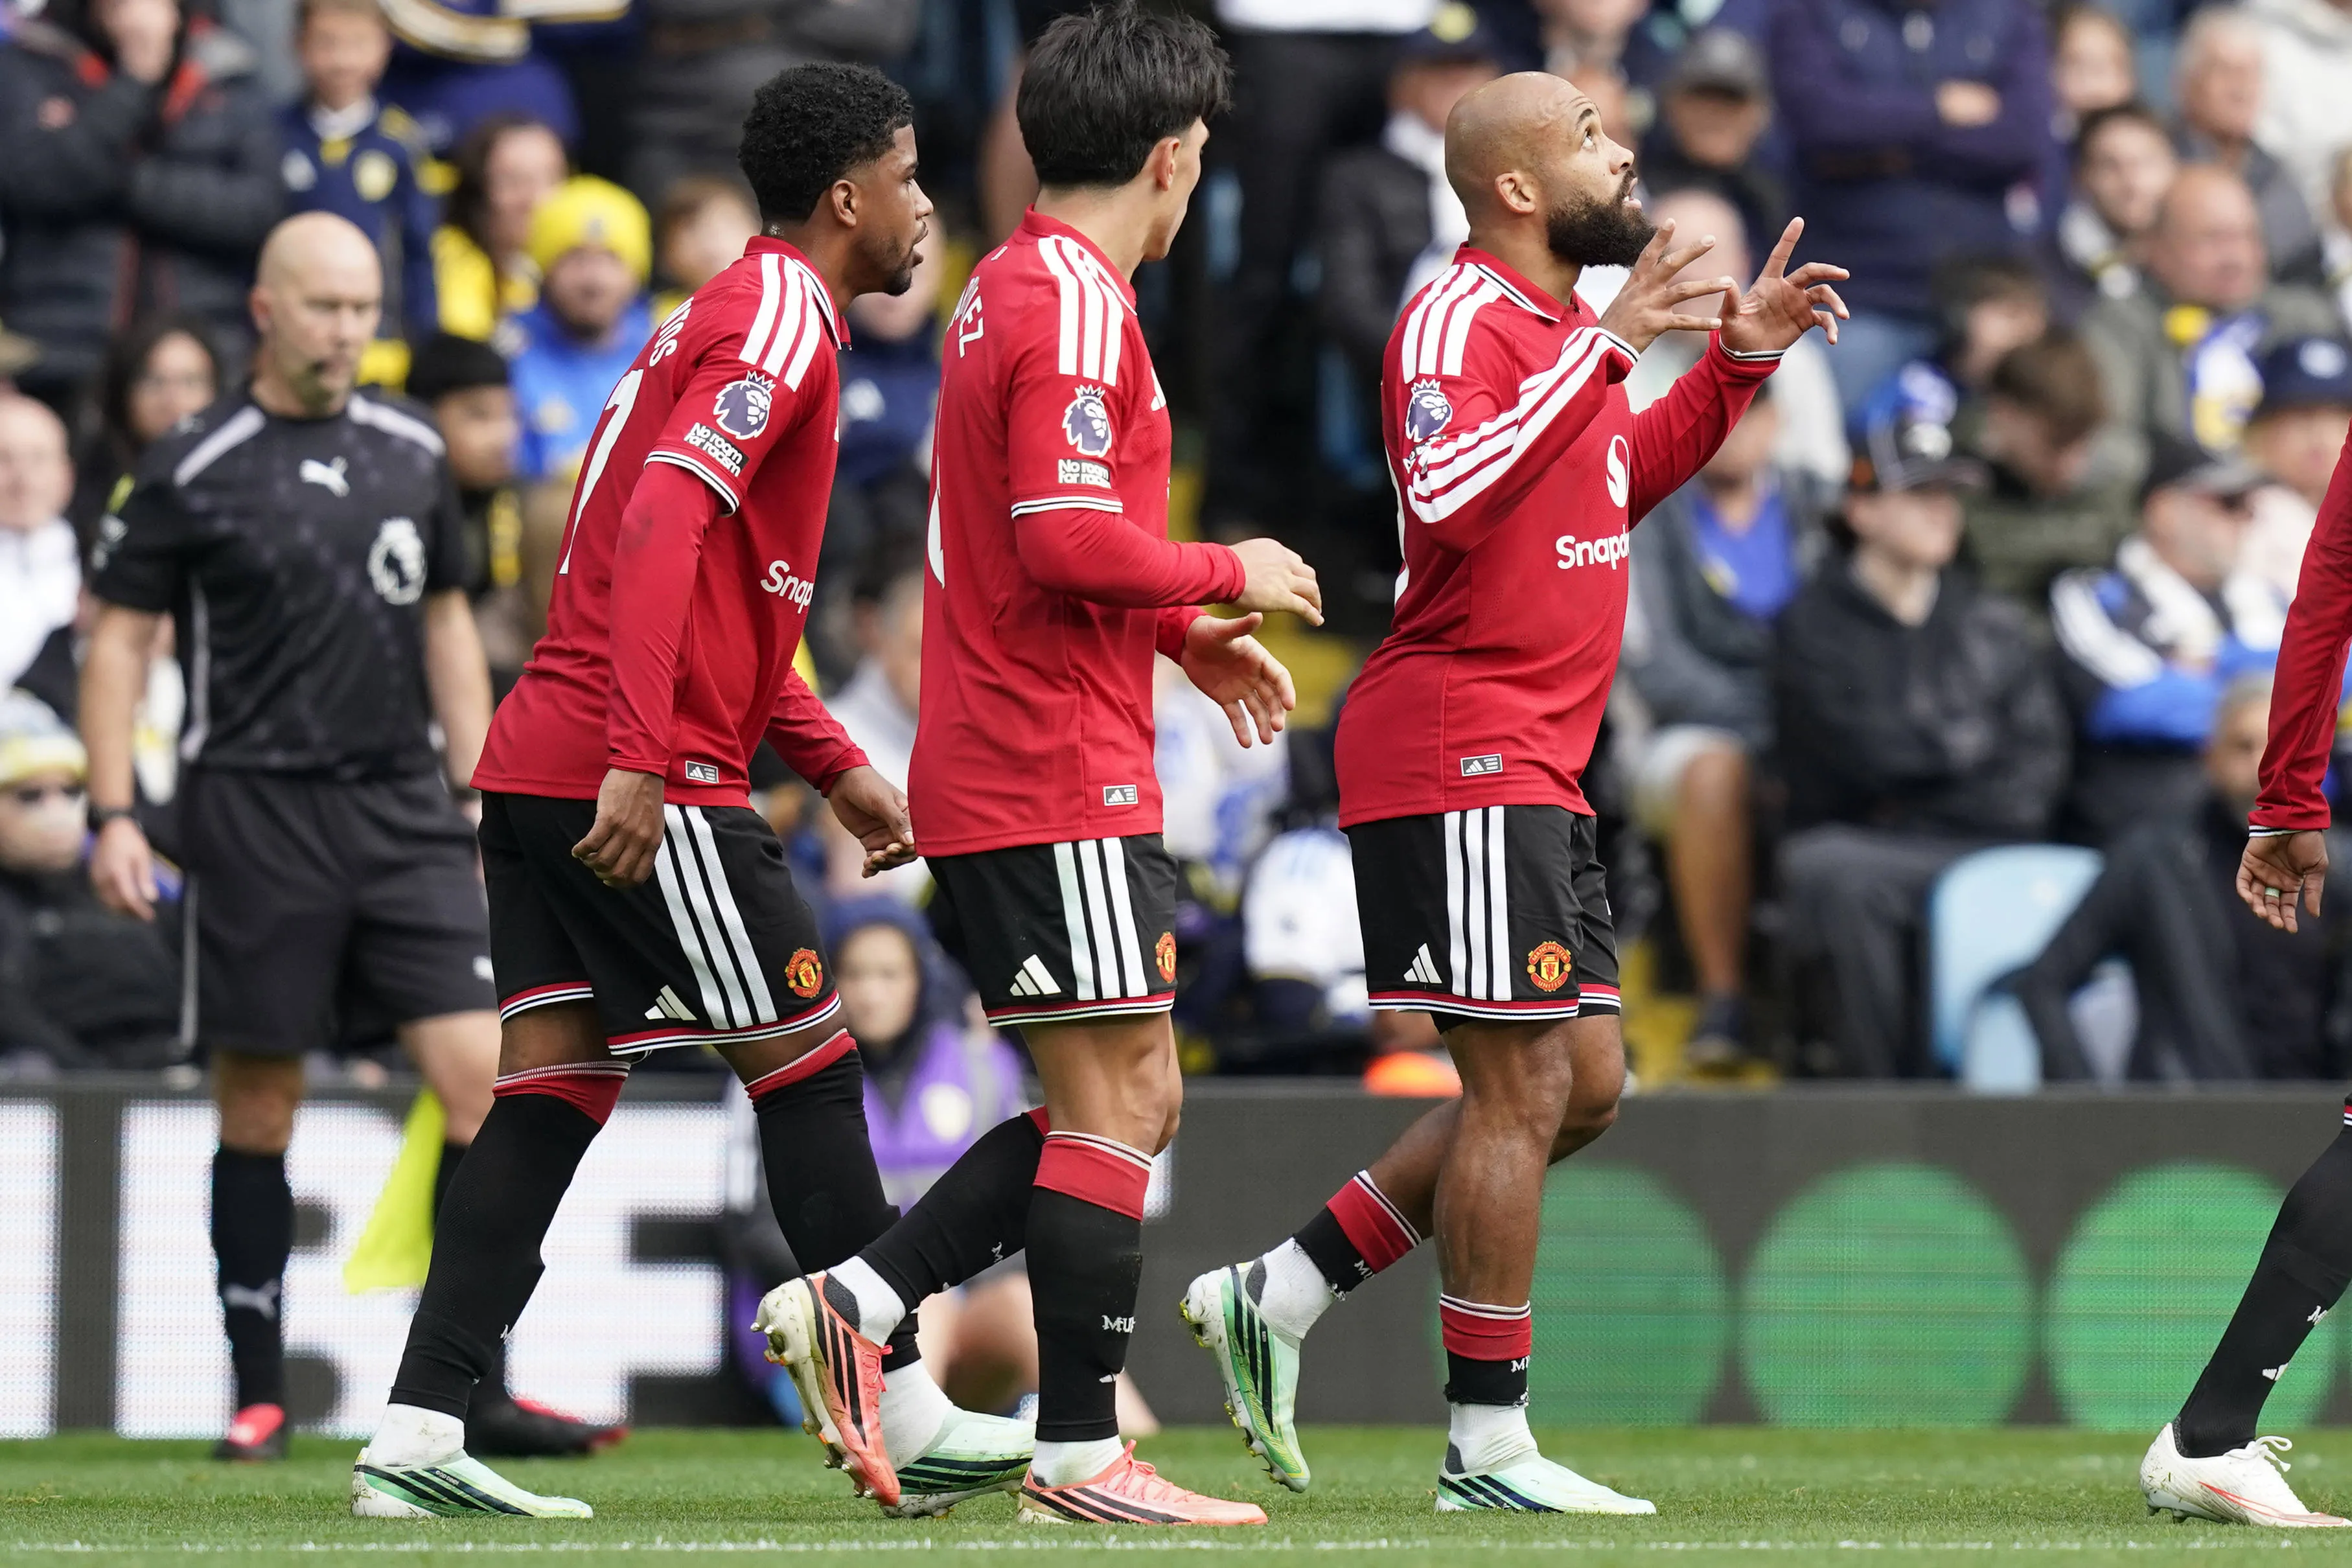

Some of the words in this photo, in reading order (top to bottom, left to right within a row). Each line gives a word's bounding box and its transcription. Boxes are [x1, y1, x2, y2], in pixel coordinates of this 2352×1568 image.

[684, 432, 706, 448] for
[691, 422, 711, 439] No
[709, 432, 743, 465] room
[1058, 459, 1080, 473] No
[1080, 461, 1109, 481] room
[1058, 472, 1080, 484] for
